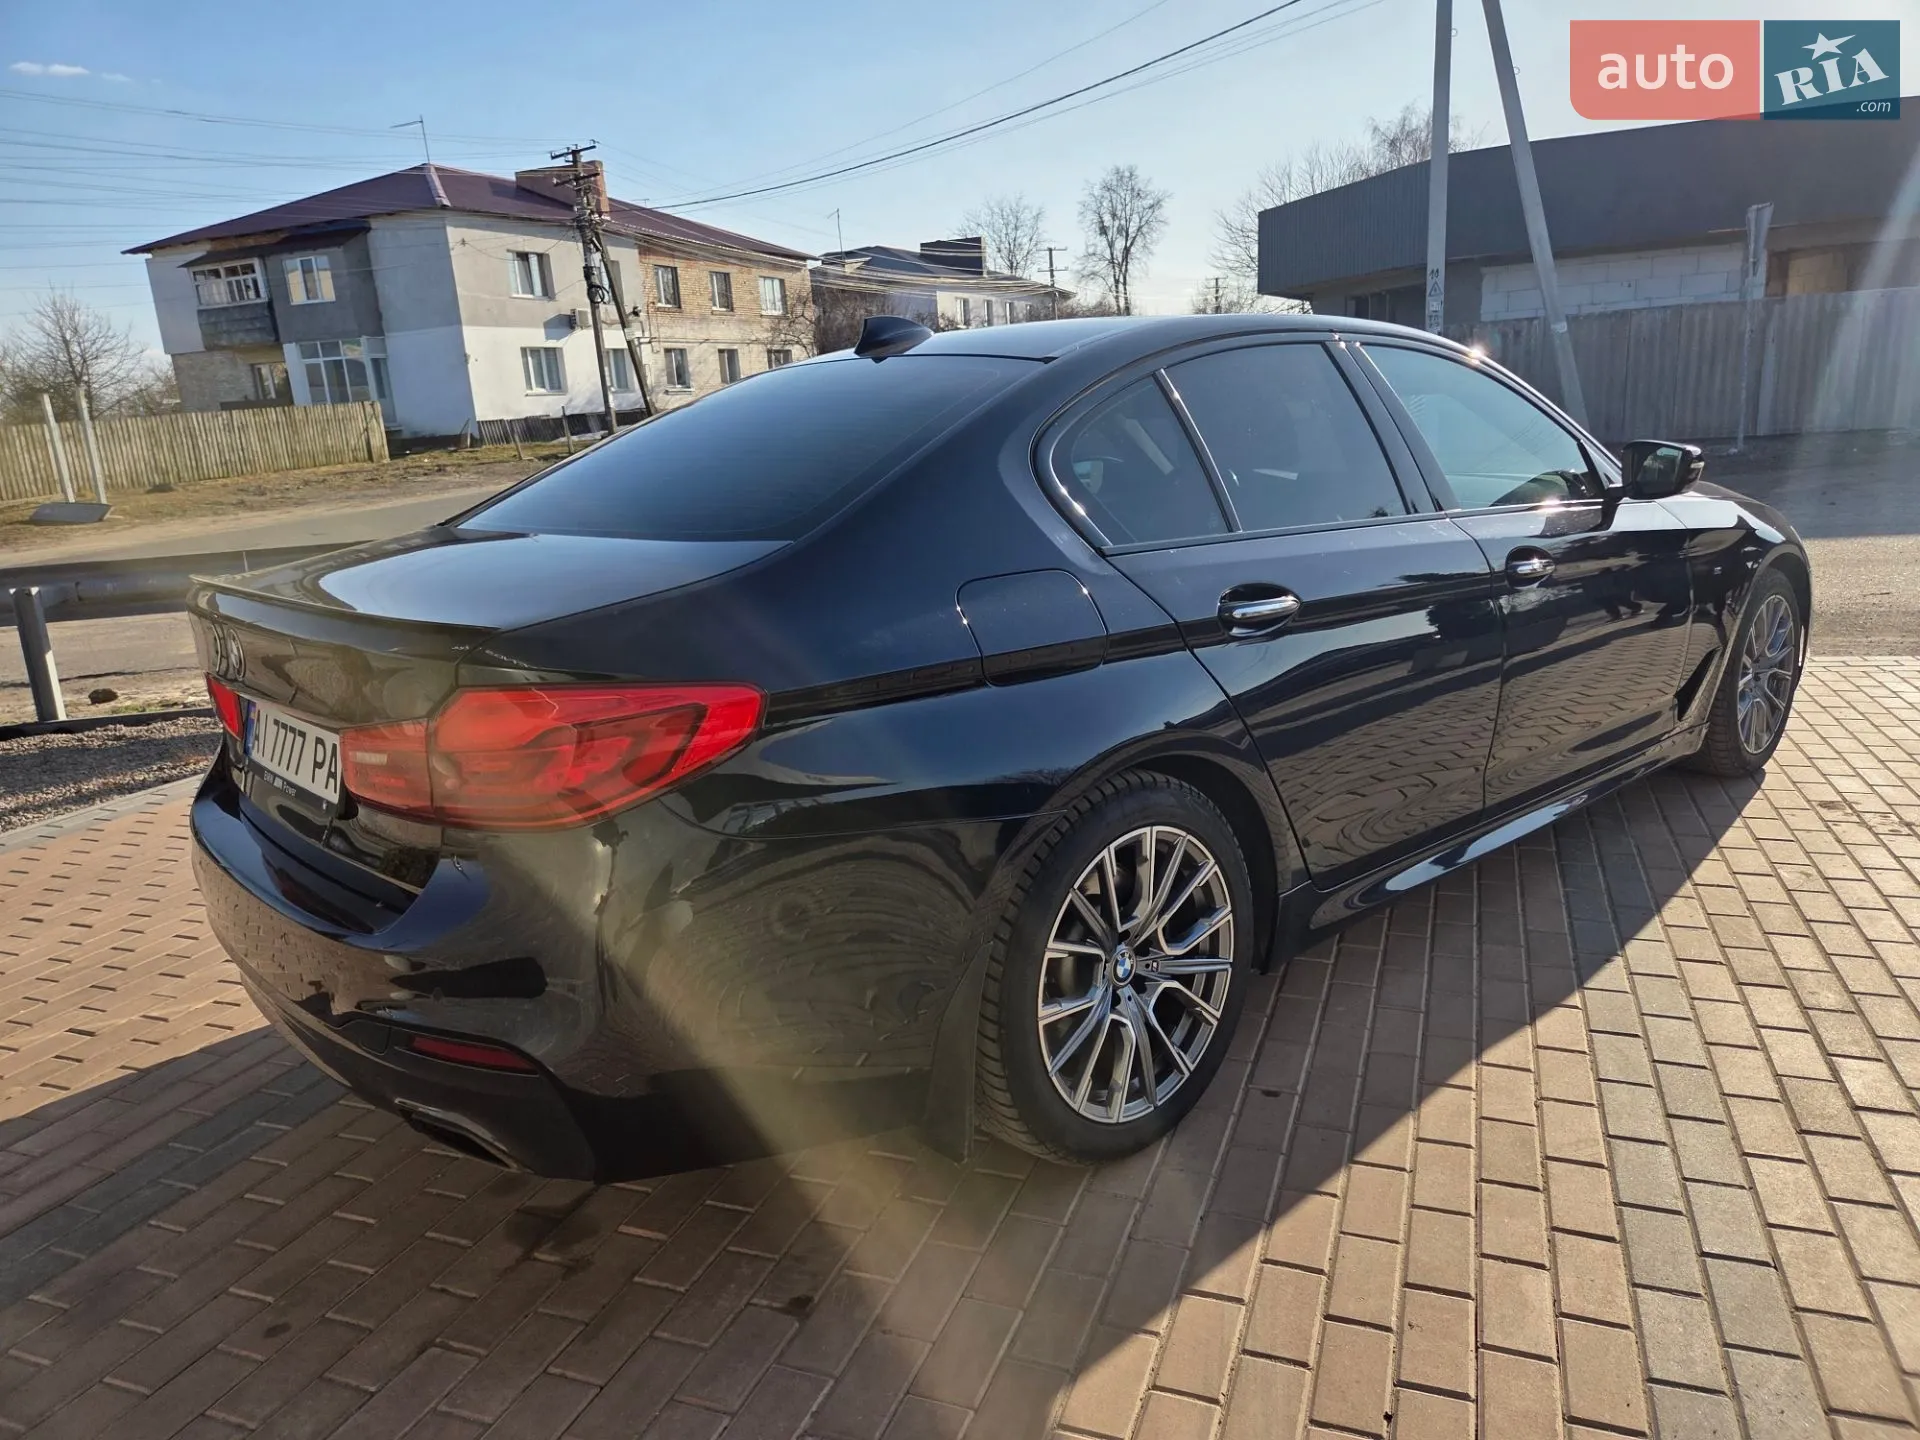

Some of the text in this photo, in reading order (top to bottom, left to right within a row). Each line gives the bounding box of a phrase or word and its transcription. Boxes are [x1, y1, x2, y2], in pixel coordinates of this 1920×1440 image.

[253, 709, 338, 795] AI 7777 PA
